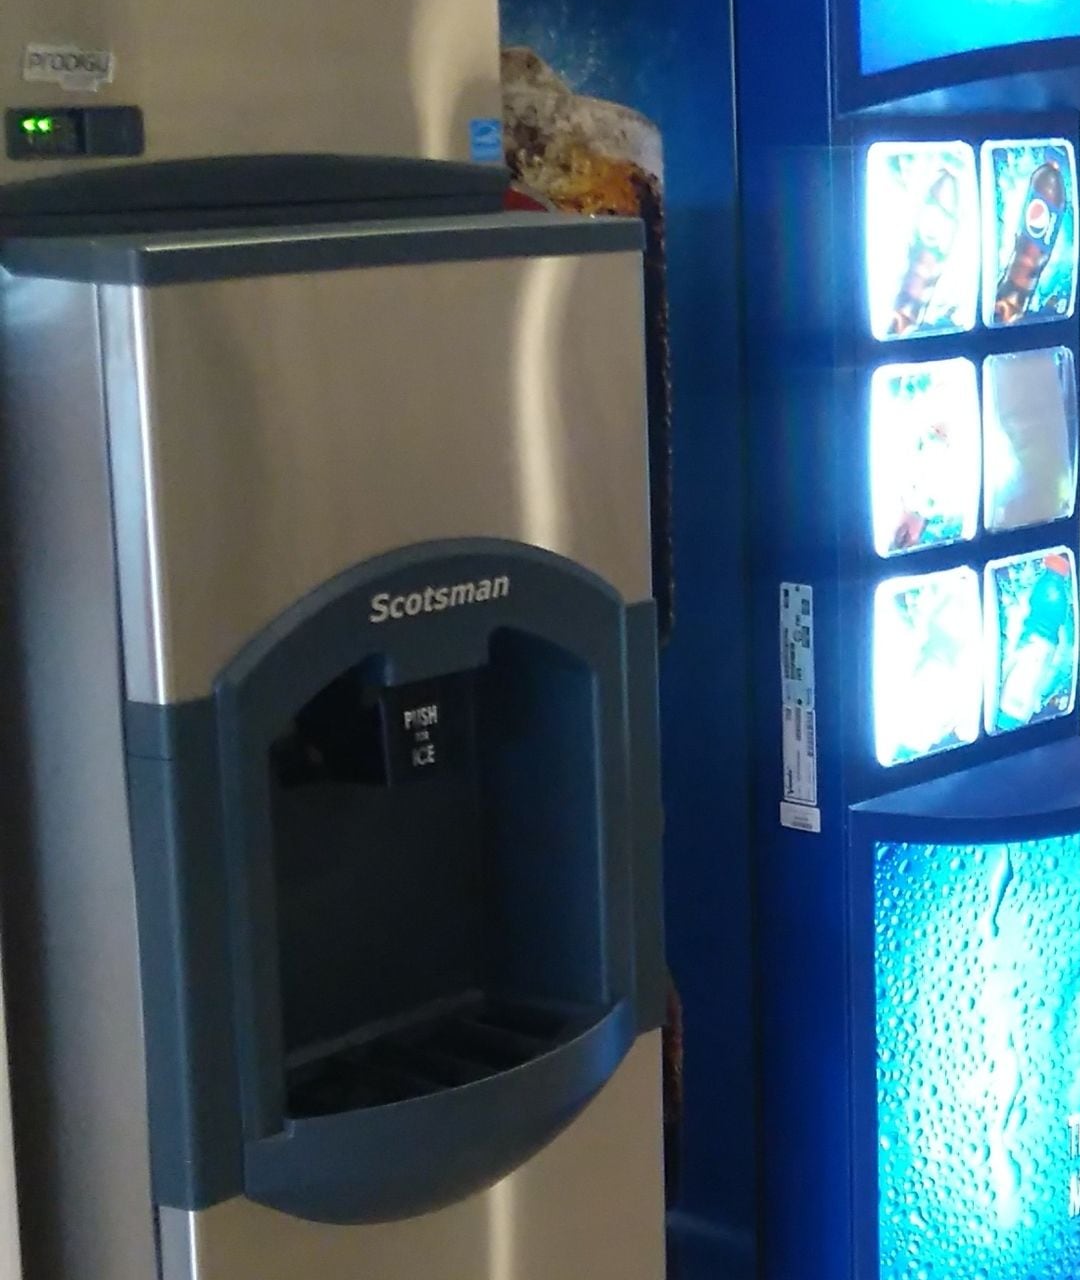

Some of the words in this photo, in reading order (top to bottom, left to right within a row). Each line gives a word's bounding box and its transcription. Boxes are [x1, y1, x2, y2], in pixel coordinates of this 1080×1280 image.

[369, 575, 510, 623] Scotsman
[403, 704, 438, 730] PUSH
[412, 743, 436, 767] ICE
